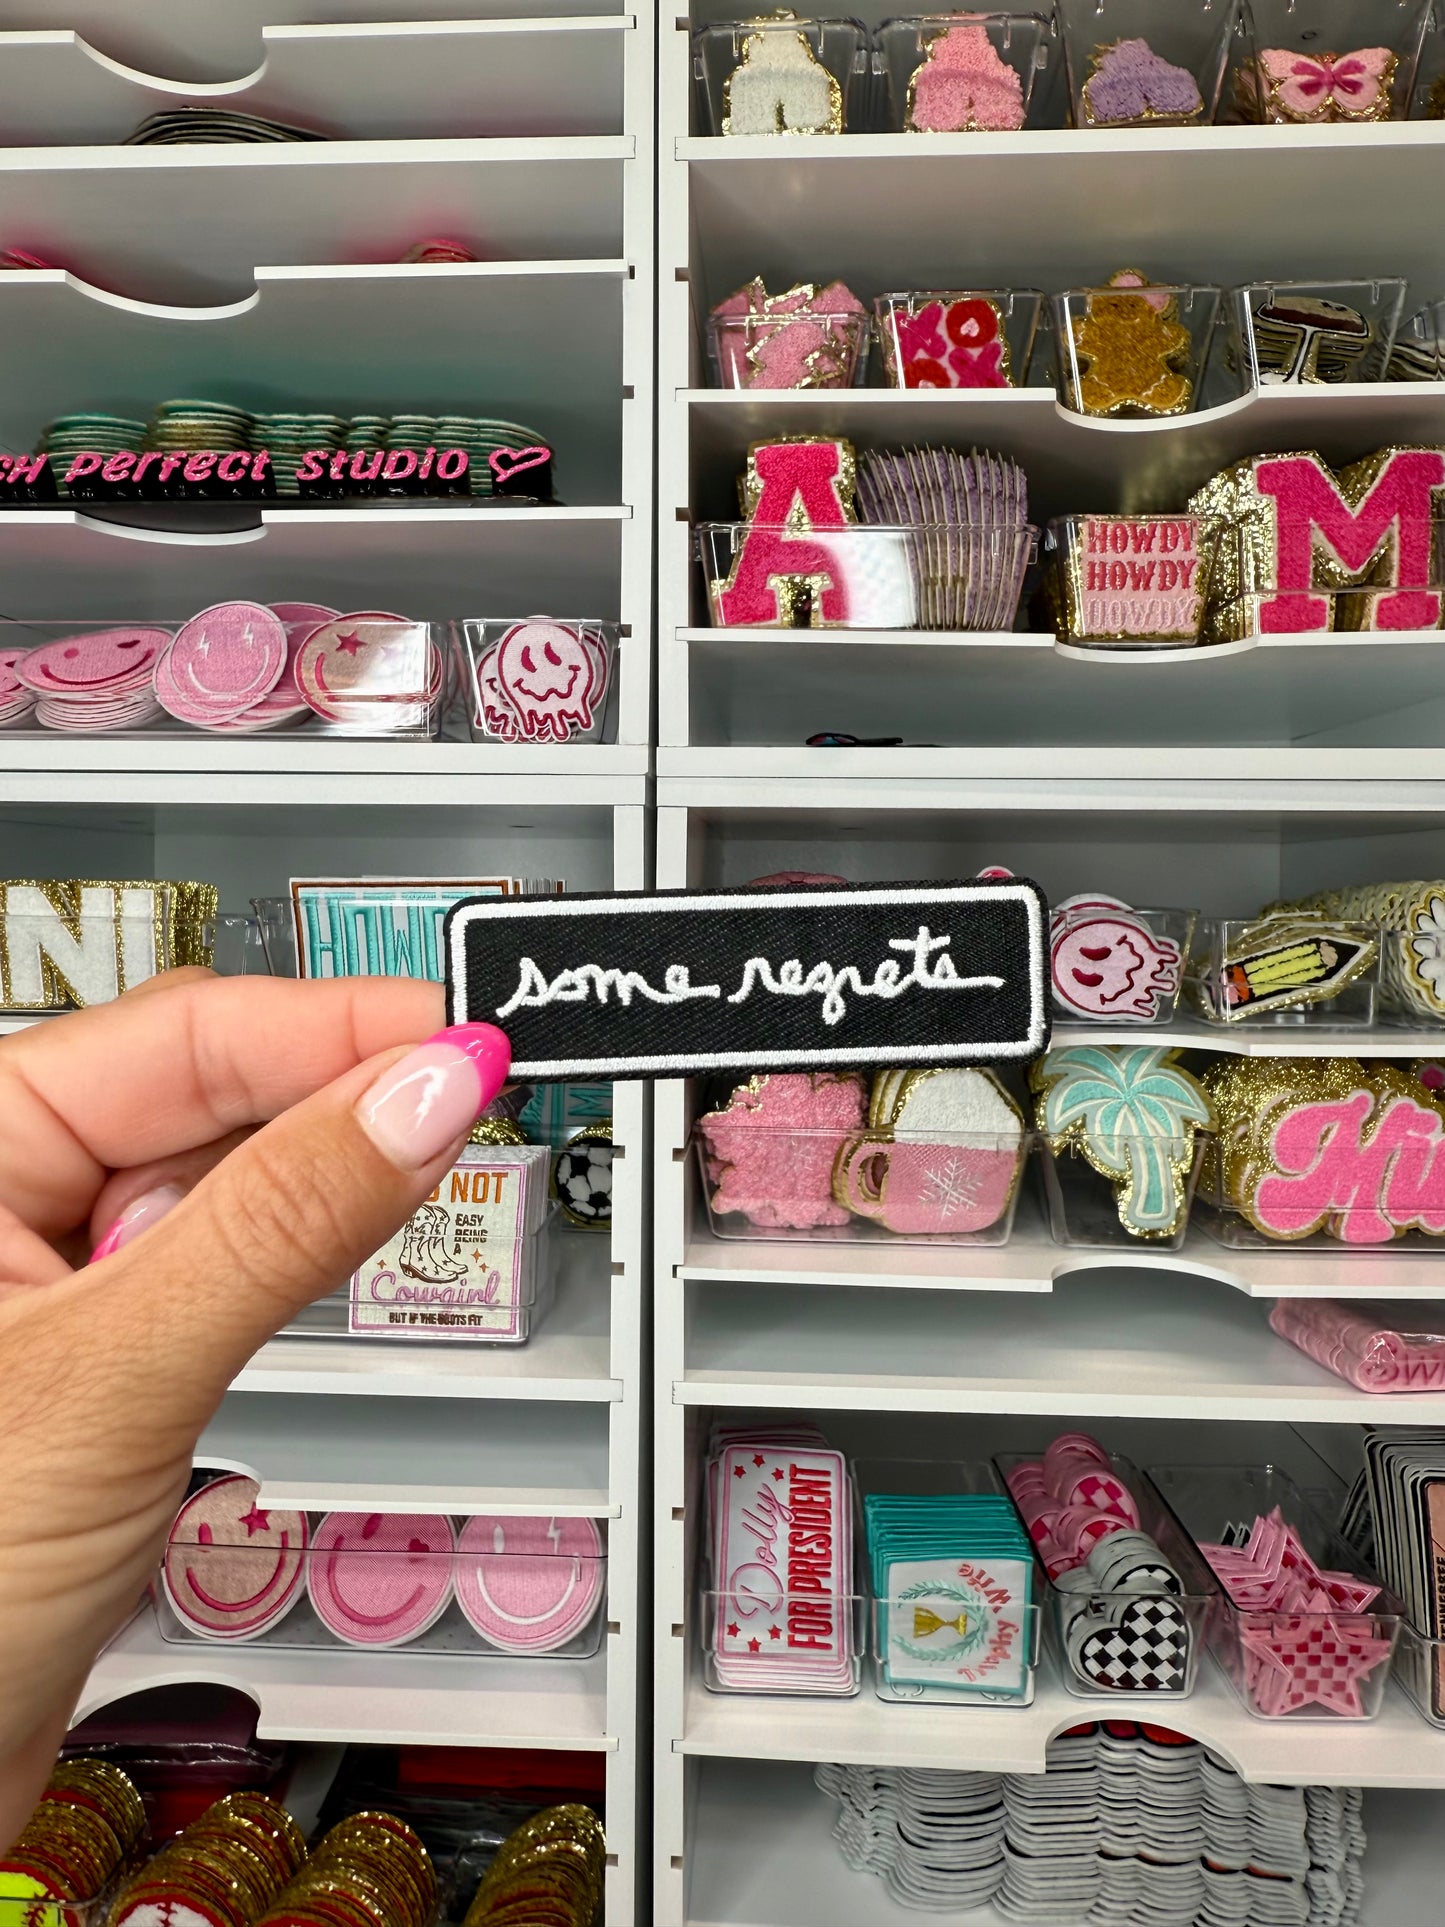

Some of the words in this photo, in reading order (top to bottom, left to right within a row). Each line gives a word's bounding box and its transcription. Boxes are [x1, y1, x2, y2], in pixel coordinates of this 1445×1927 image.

[717, 442, 850, 626] A
[1087, 520, 1197, 554] HOWDY
[1255, 451, 1445, 633] M
[1086, 559, 1197, 591] HOWDY
[1086, 597, 1196, 630] HOWDY
[496, 957, 720, 1018] some
[727, 926, 1005, 1025] regrets
[451, 1172, 508, 1204] NOT
[454, 1229, 488, 1243] BEING
[455, 1213, 484, 1227] EASY
[453, 1243, 462, 1256] A
[371, 1270, 501, 1313] Cowgirl
[389, 1312, 407, 1324] BUT
[409, 1312, 418, 1325] IF
[420, 1313, 437, 1325] THE
[437, 1313, 467, 1326] BOOTS
[468, 1313, 483, 1326] FIT
[729, 1482, 796, 1621] Dolly
[787, 1463, 833, 1598] PRESIDENT
[958, 1563, 1012, 1614] Wife
[787, 1601, 834, 1651] FOR
[957, 1619, 1019, 1682] Trophy
